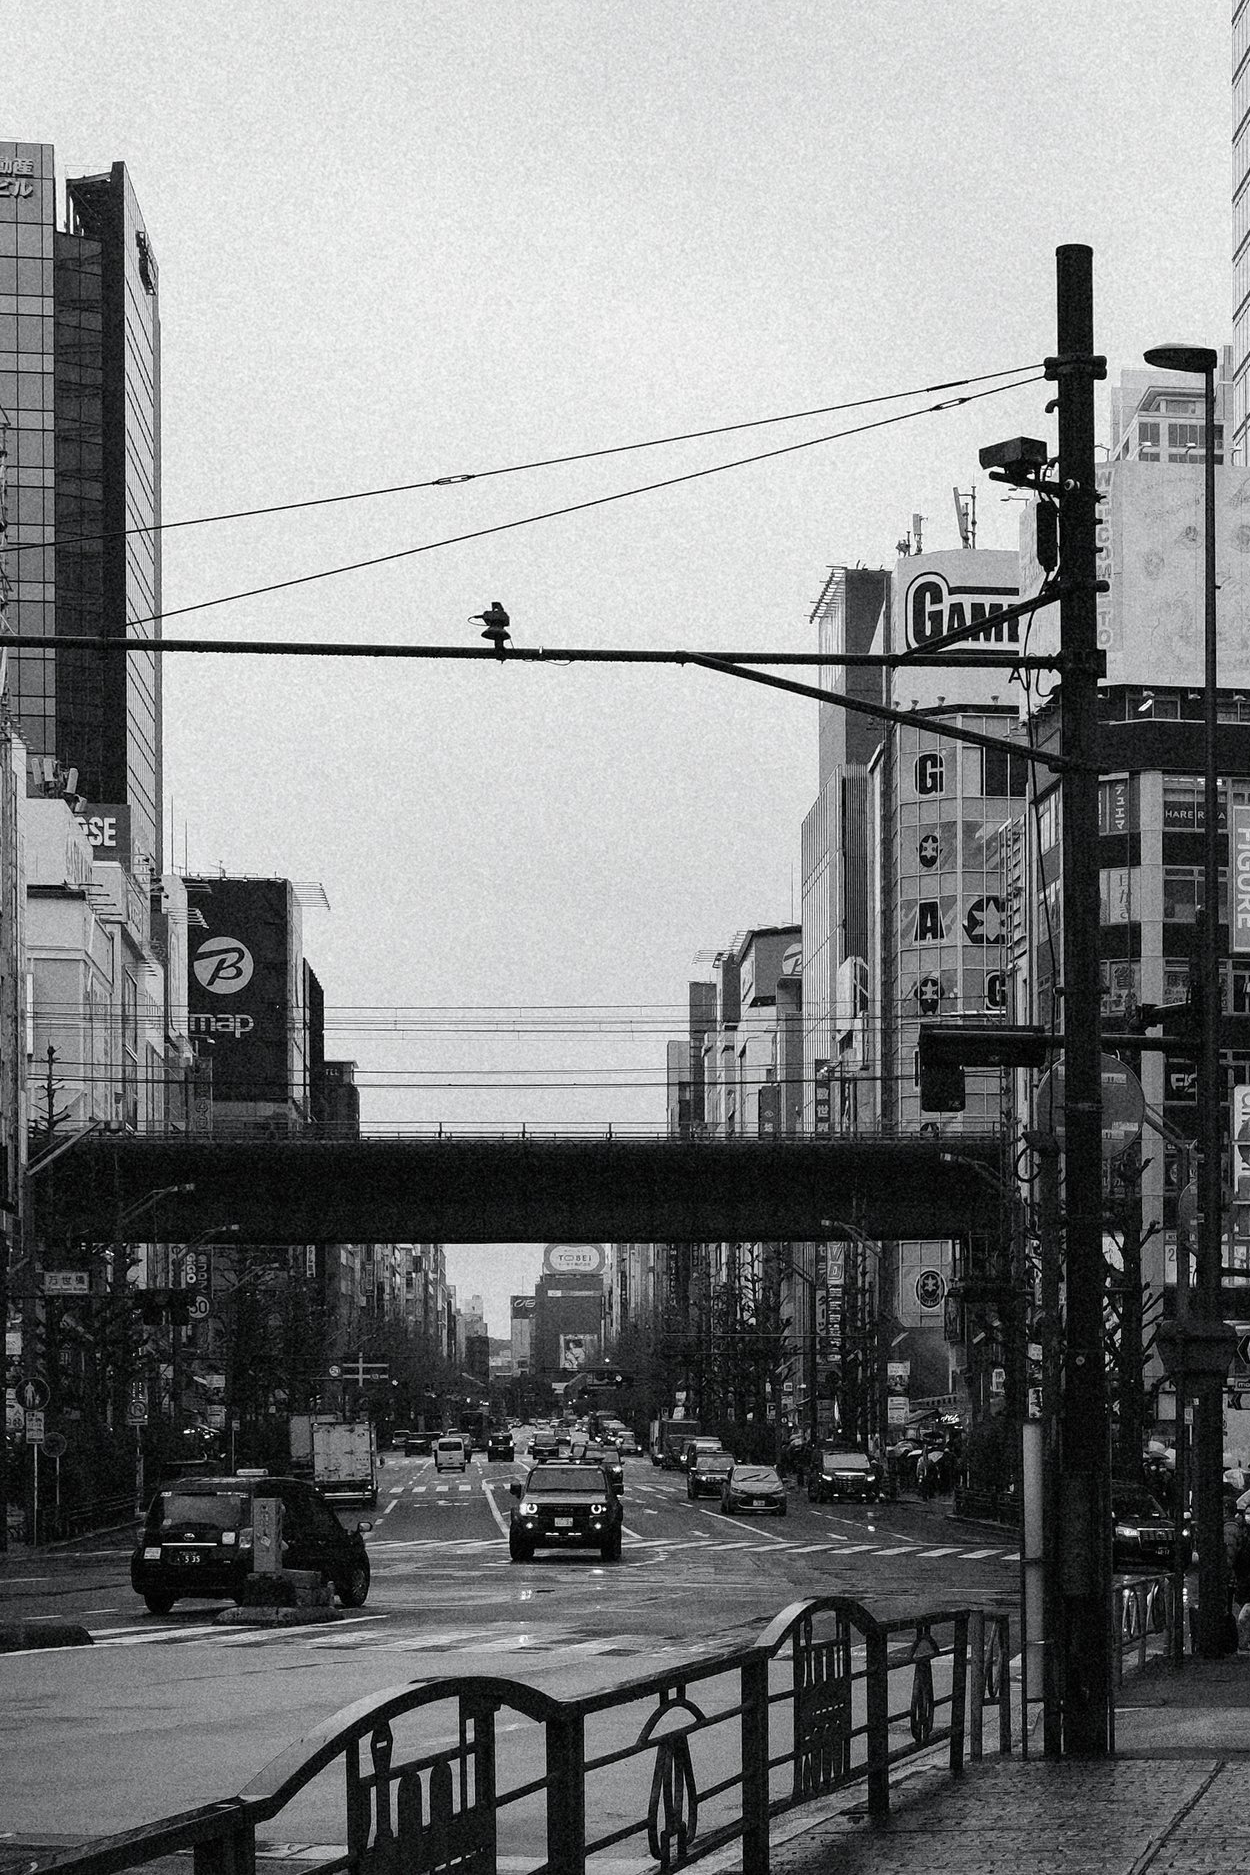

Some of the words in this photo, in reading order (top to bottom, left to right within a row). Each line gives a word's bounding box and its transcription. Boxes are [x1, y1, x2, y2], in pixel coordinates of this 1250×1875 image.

[1115, 784, 1126, 830] デュエマ
[1165, 809, 1226, 820] HARERA
[48, 1274, 86, 1286] 万世橋
